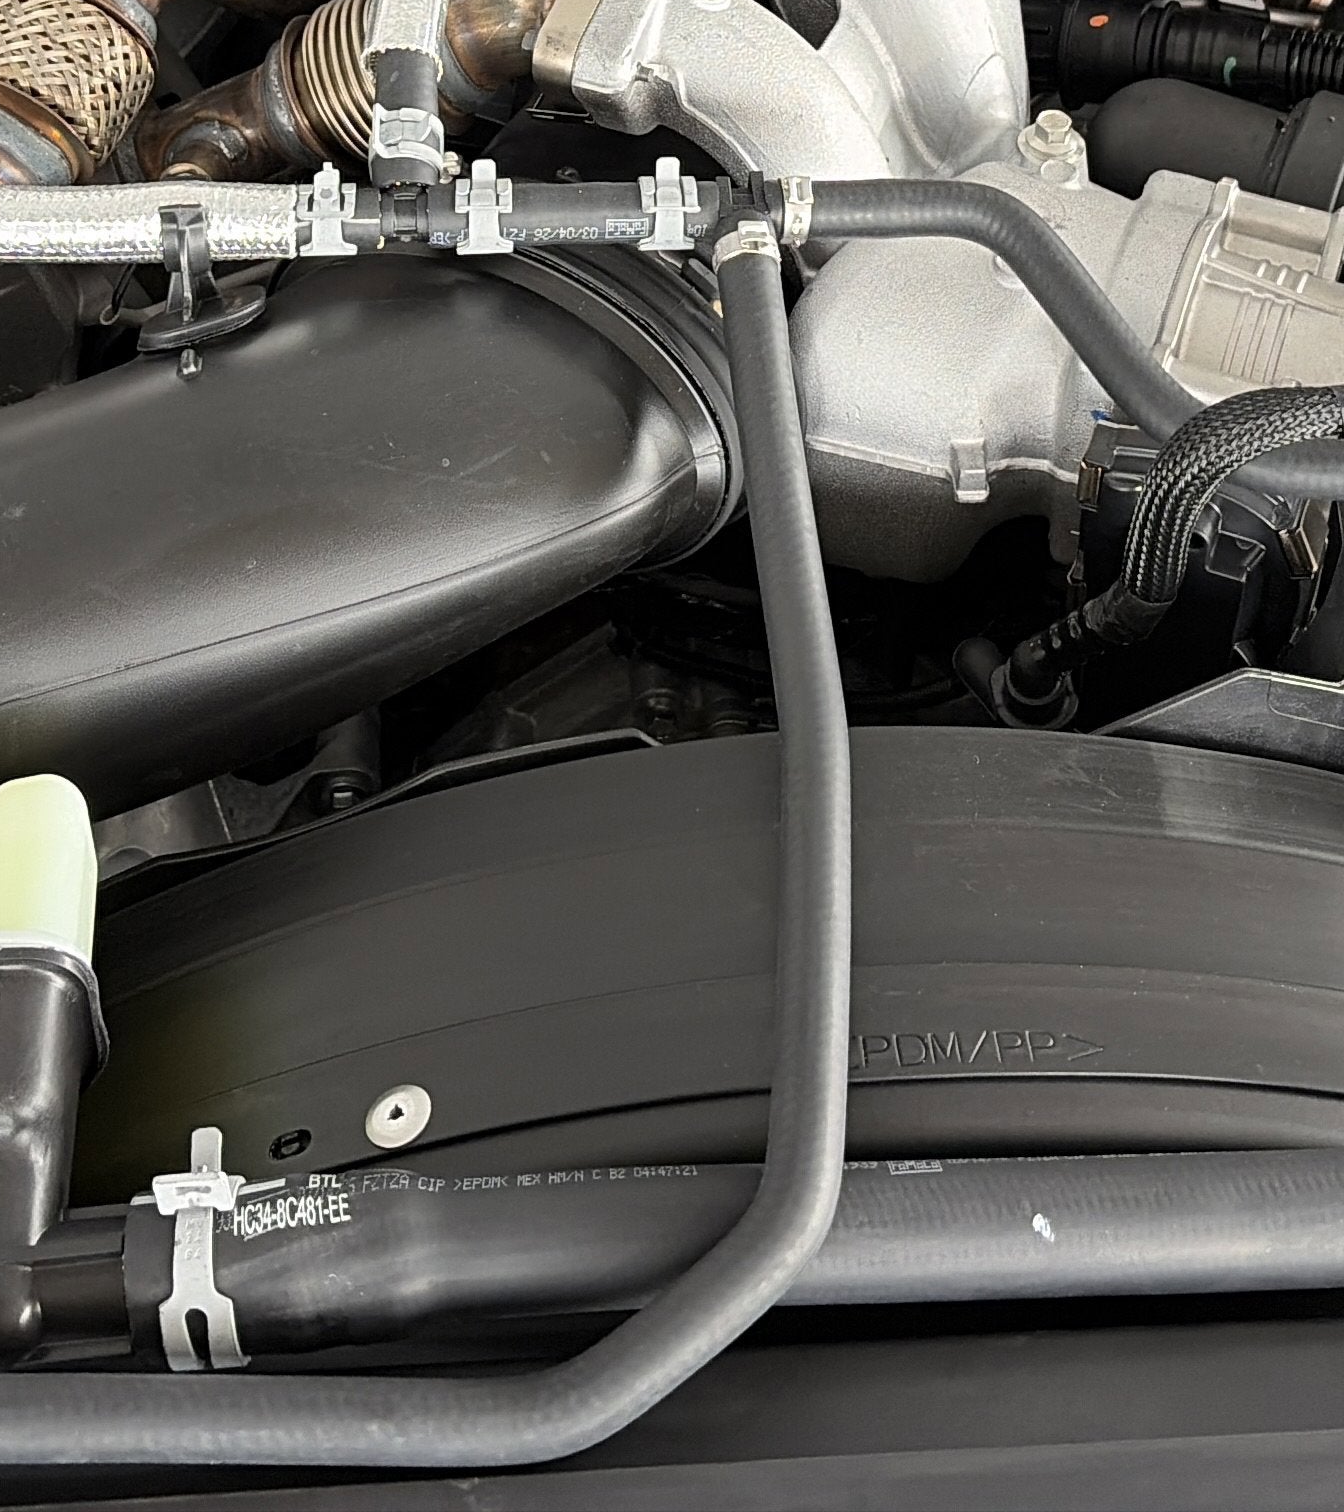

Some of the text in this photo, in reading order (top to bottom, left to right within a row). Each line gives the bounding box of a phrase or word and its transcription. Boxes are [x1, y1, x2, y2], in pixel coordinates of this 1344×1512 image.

[533, 226, 599, 242] 03/04/26
[308, 1174, 342, 1189] BTL
[417, 1177, 445, 1192] CIP
[453, 1176, 508, 1191] >EPDM<
[516, 1174, 541, 1186] MEX
[609, 1168, 626, 1179] B2
[633, 1165, 698, 1178] 04:47:21
[233, 1192, 352, 1237] HC34-8C481-EE
